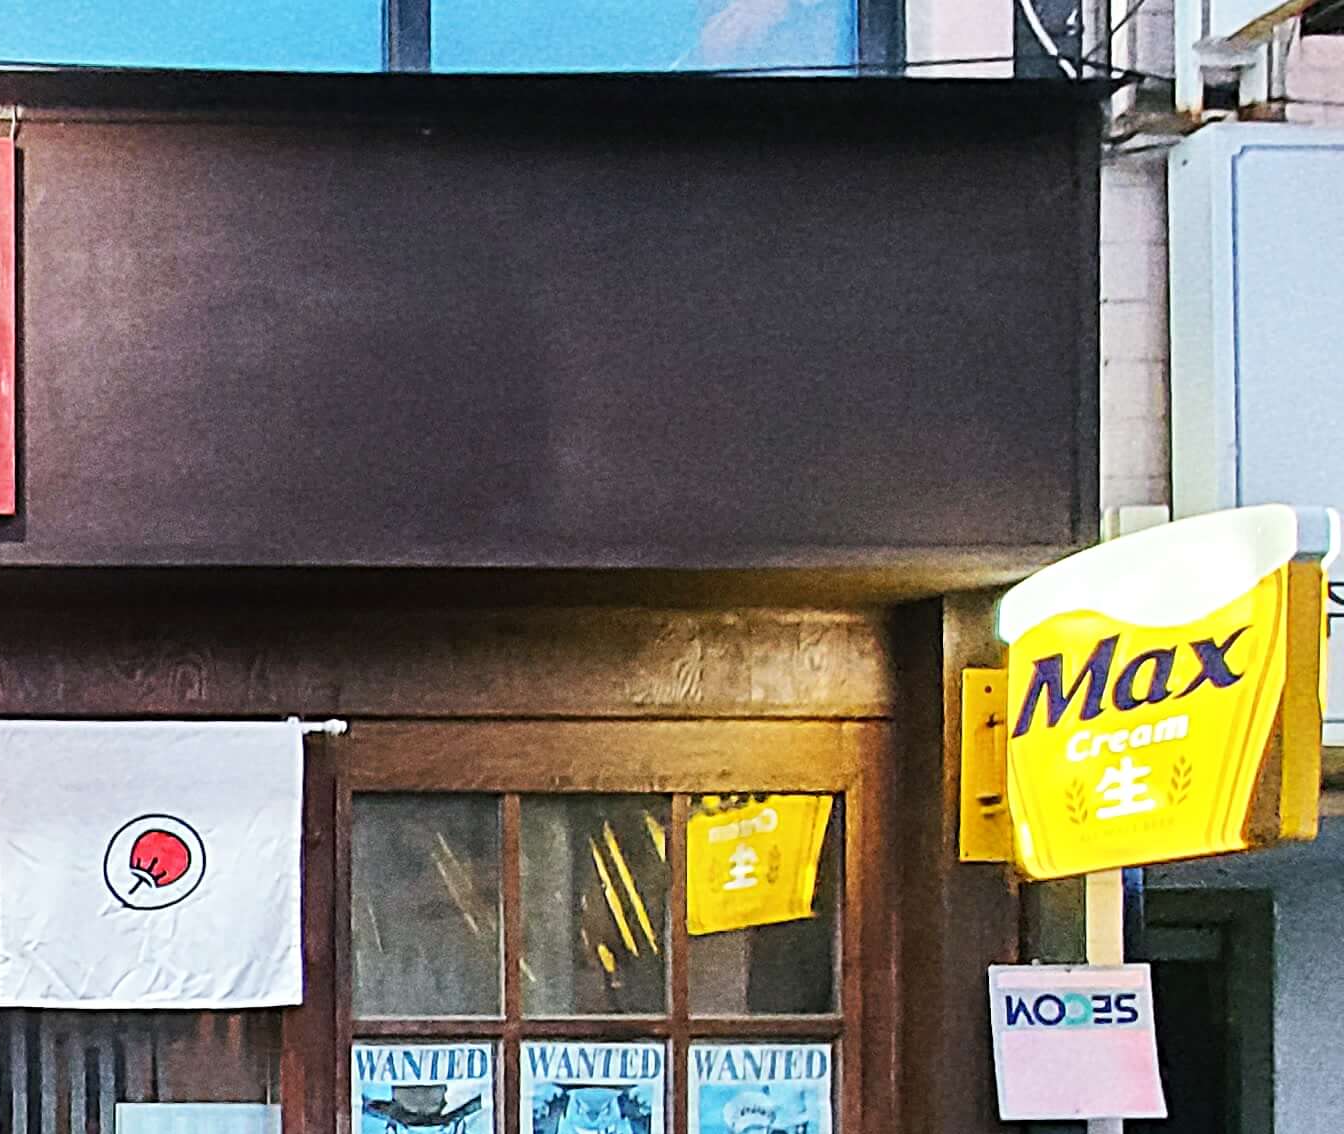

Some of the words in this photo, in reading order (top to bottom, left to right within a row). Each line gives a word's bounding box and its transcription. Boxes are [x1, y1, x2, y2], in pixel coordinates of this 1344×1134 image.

[1010, 624, 1254, 740] Max
[1065, 712, 1190, 762] Cream
[1094, 754, 1158, 820] 生
[355, 1047, 489, 1081] WANTED
[526, 1046, 662, 1080] WANTED
[693, 1047, 828, 1081] WANTED
